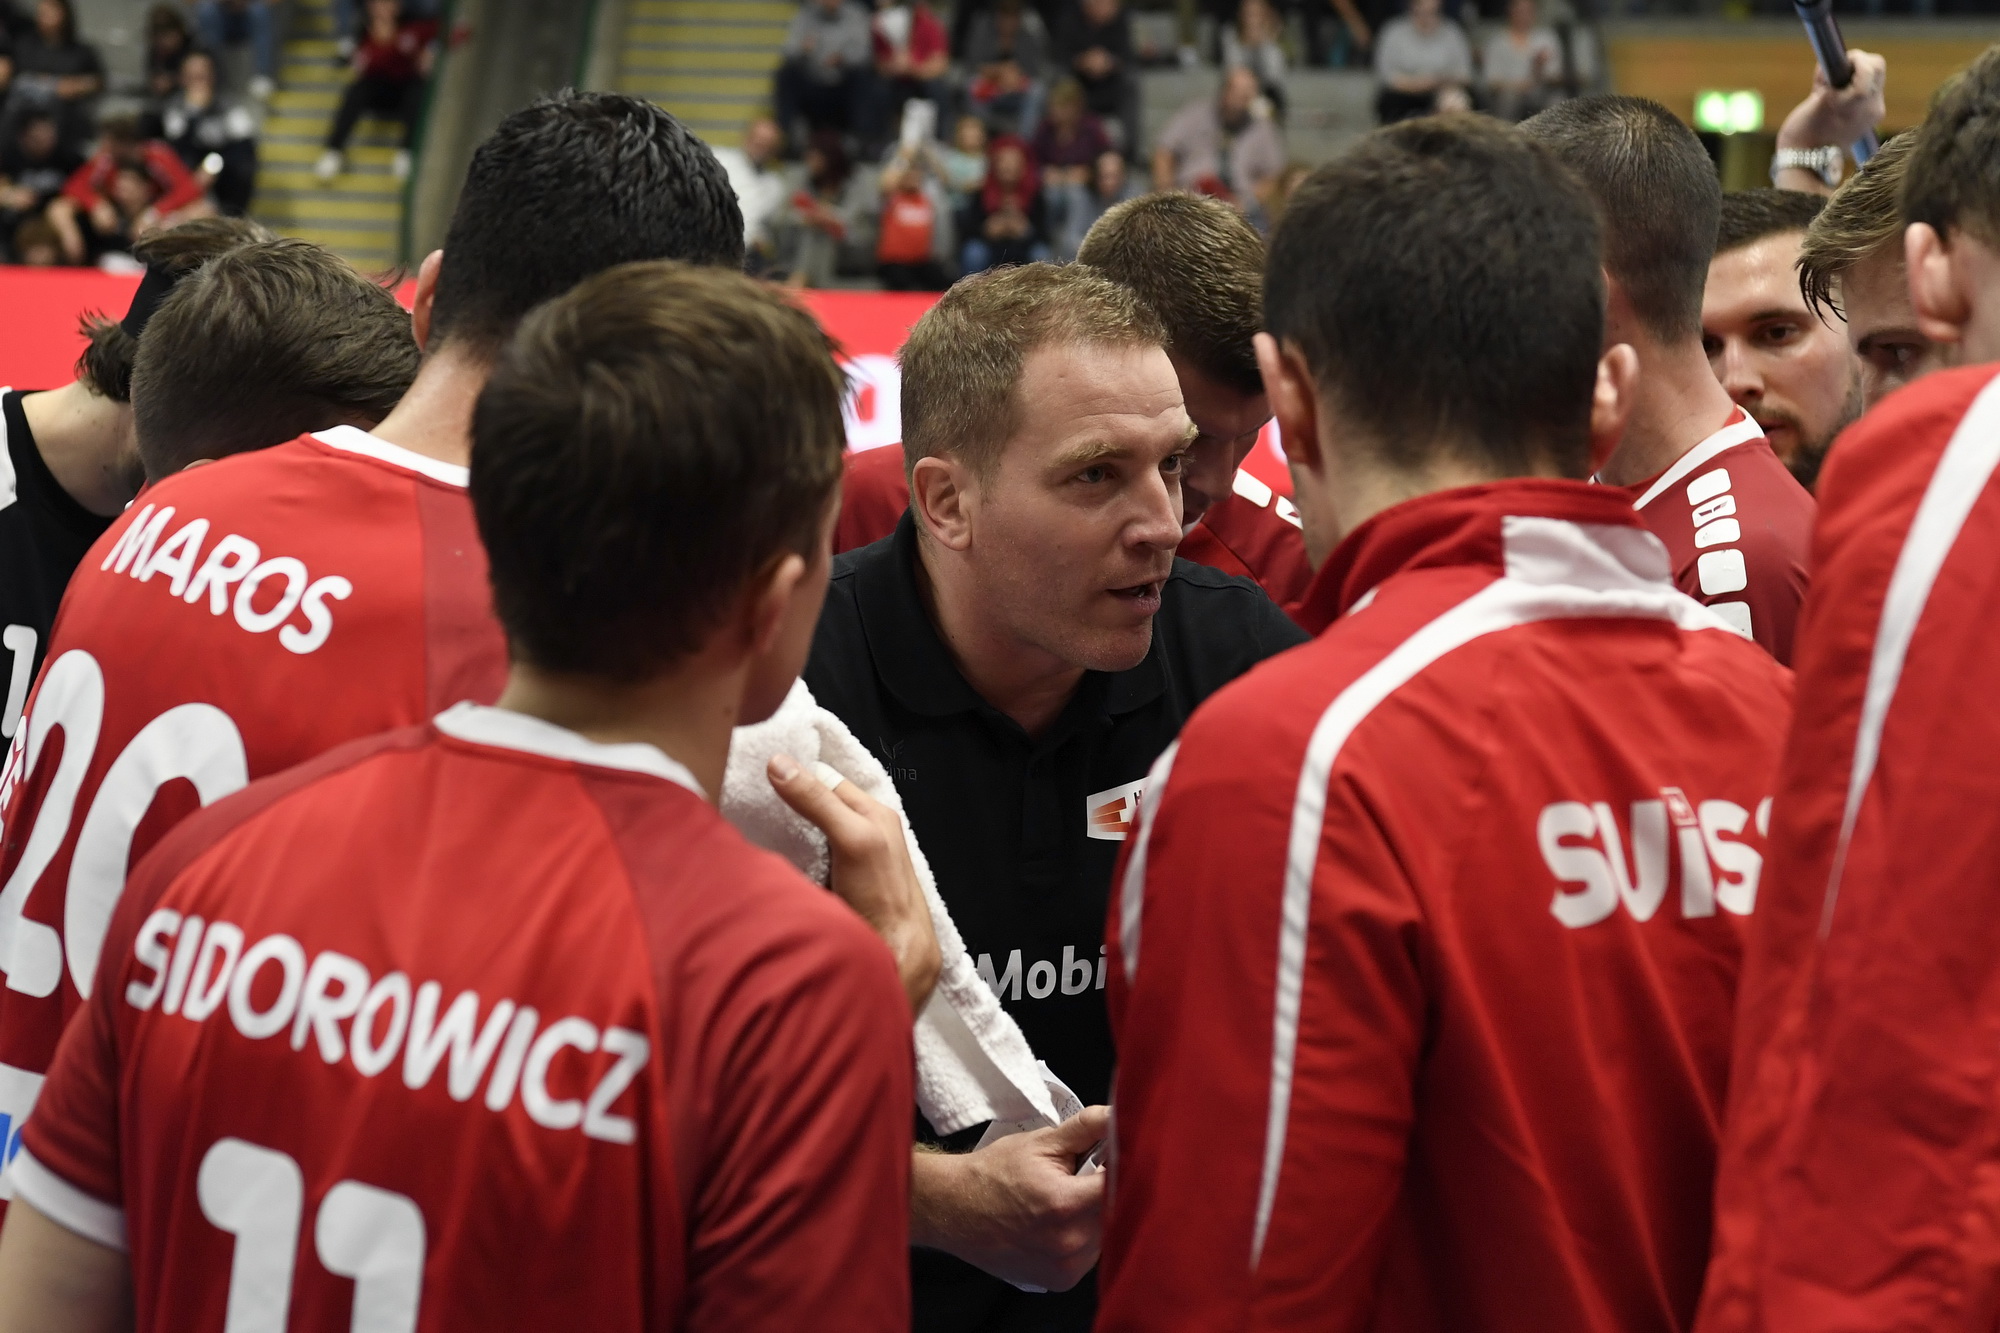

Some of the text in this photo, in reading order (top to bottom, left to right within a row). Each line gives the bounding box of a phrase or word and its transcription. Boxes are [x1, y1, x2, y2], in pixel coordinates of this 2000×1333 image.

[102, 504, 352, 654] MAROS
[0, 649, 249, 1001] 20
[126, 908, 649, 1144] SIDOROWICZ
[197, 1136, 426, 1333] 11
